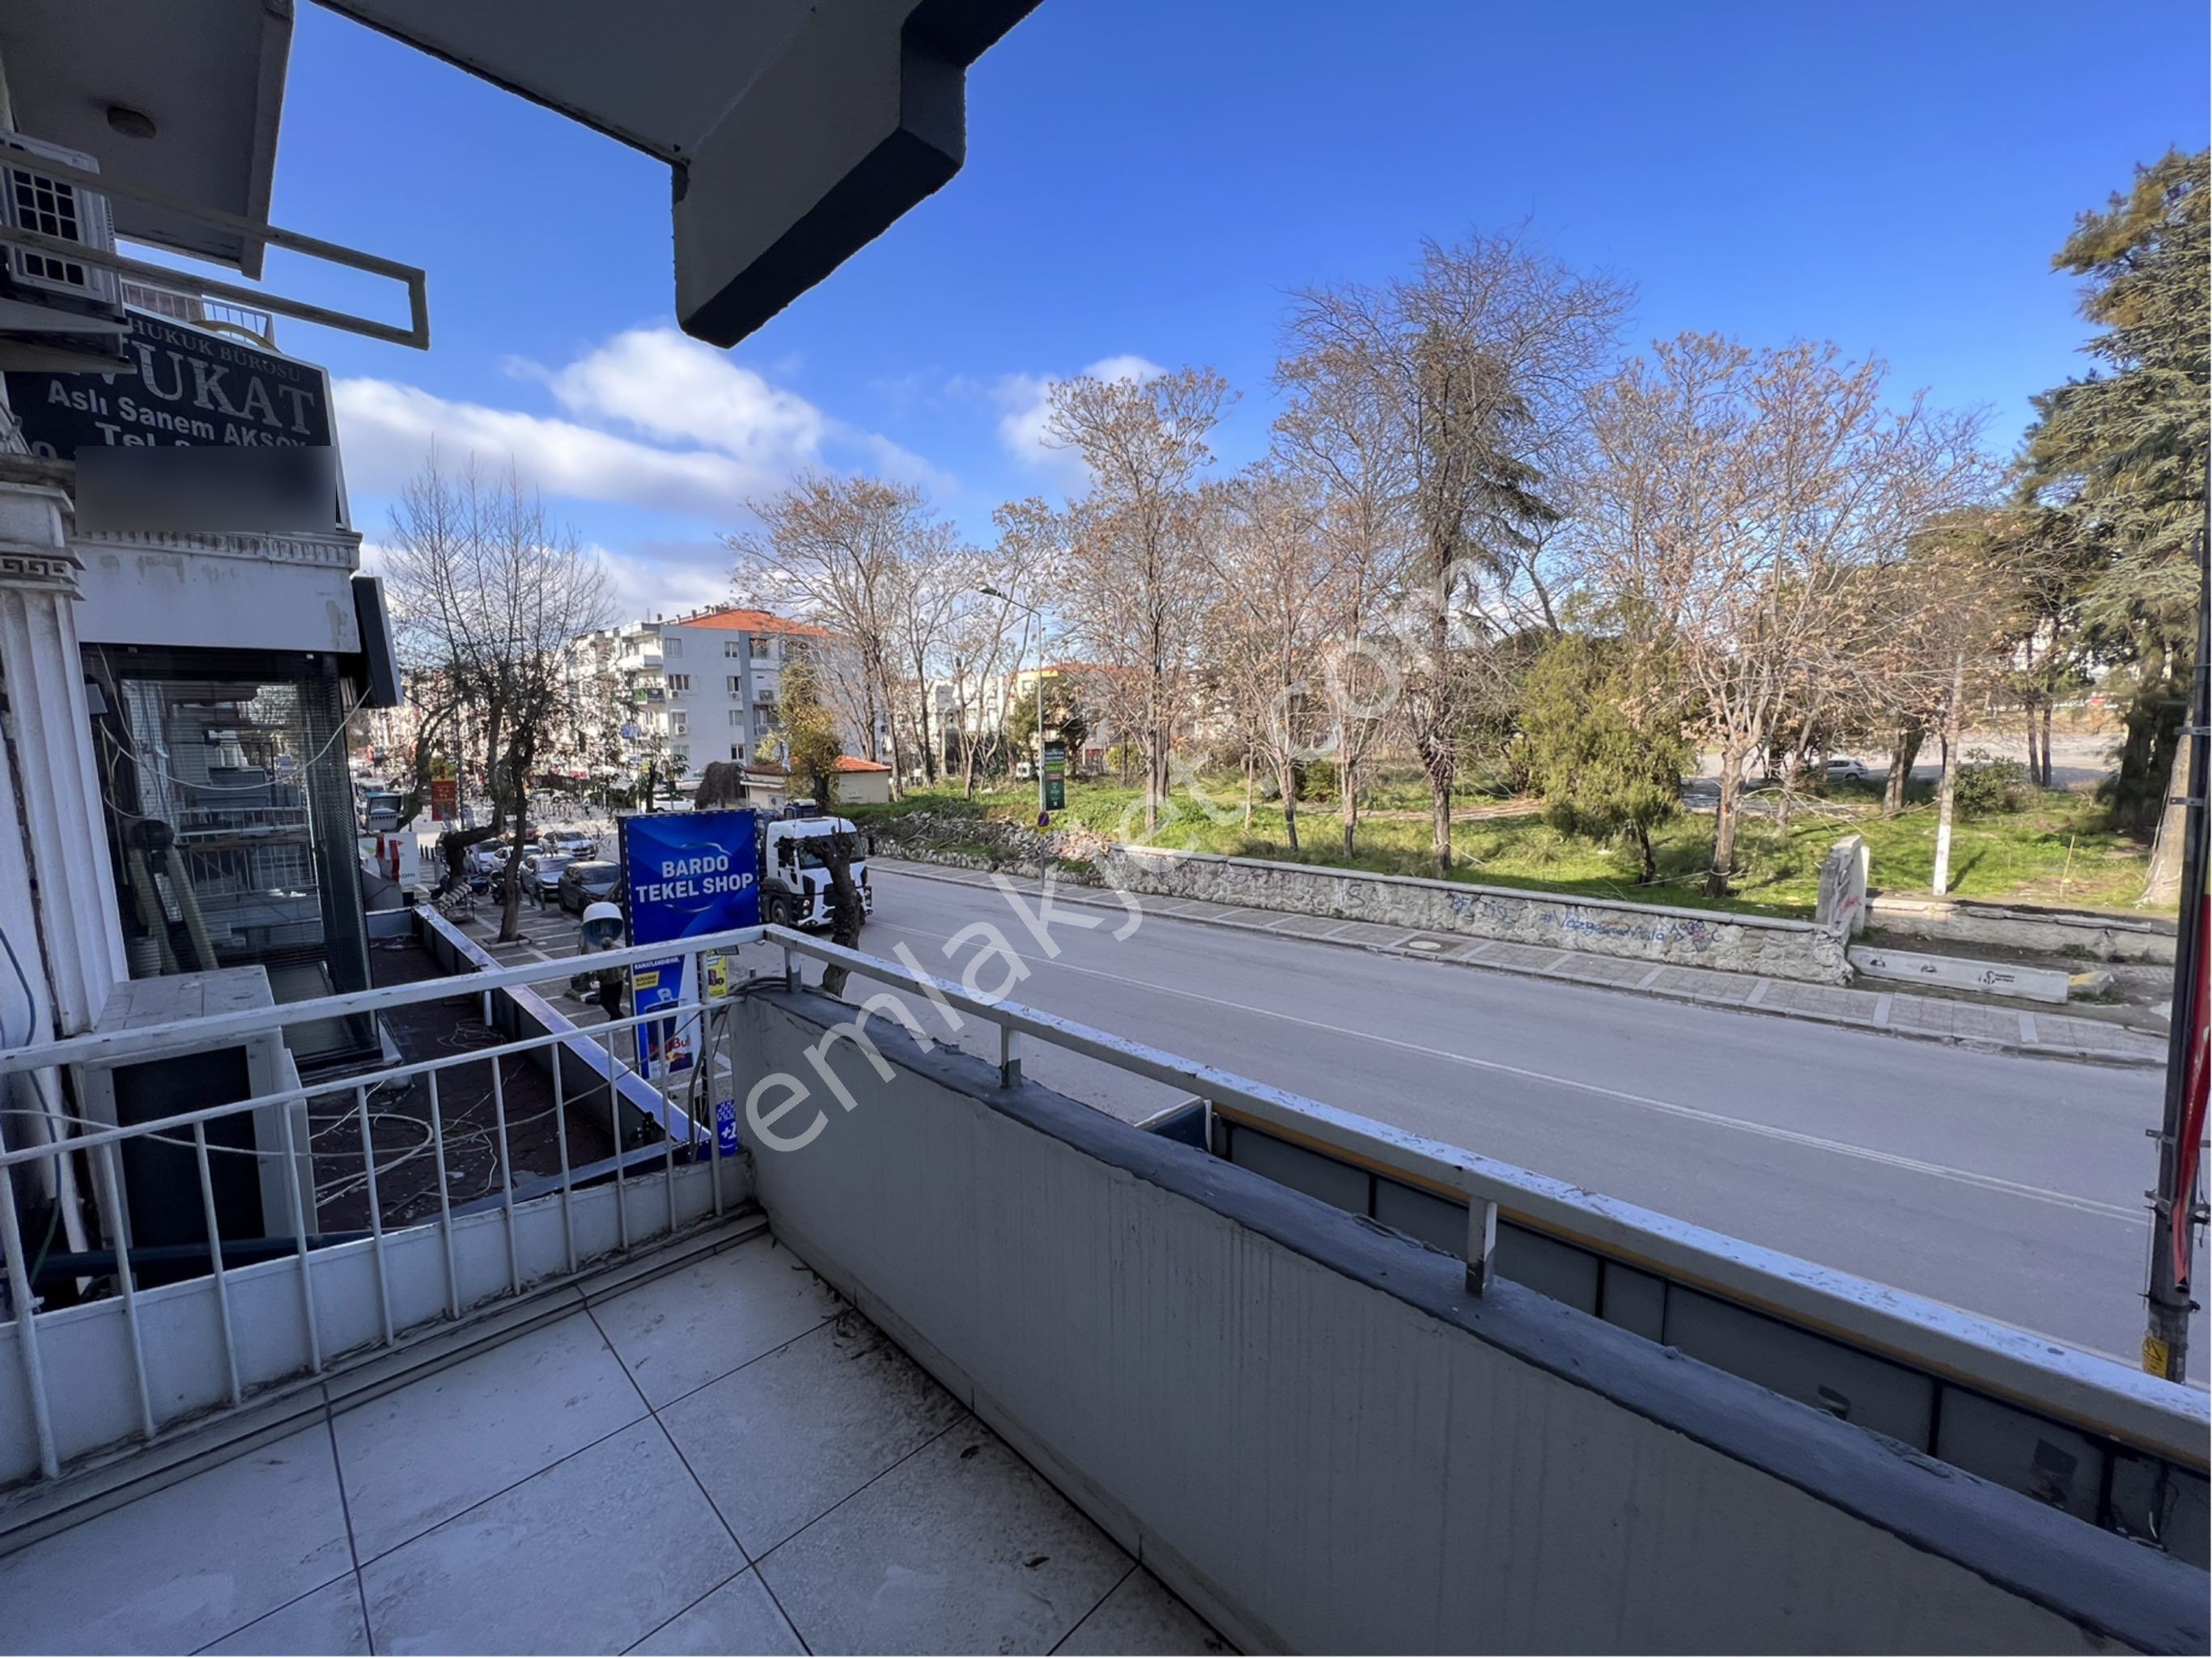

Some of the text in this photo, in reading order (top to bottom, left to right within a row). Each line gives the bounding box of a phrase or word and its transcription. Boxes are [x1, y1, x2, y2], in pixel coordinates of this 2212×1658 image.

[128, 316, 214, 357] HUKUK
[99, 337, 315, 435] UKAT
[46, 380, 109, 417] Aslı
[117, 396, 215, 441] Sanem
[661, 854, 729, 879] BARDO
[635, 872, 754, 904] TEKEL SHOP
